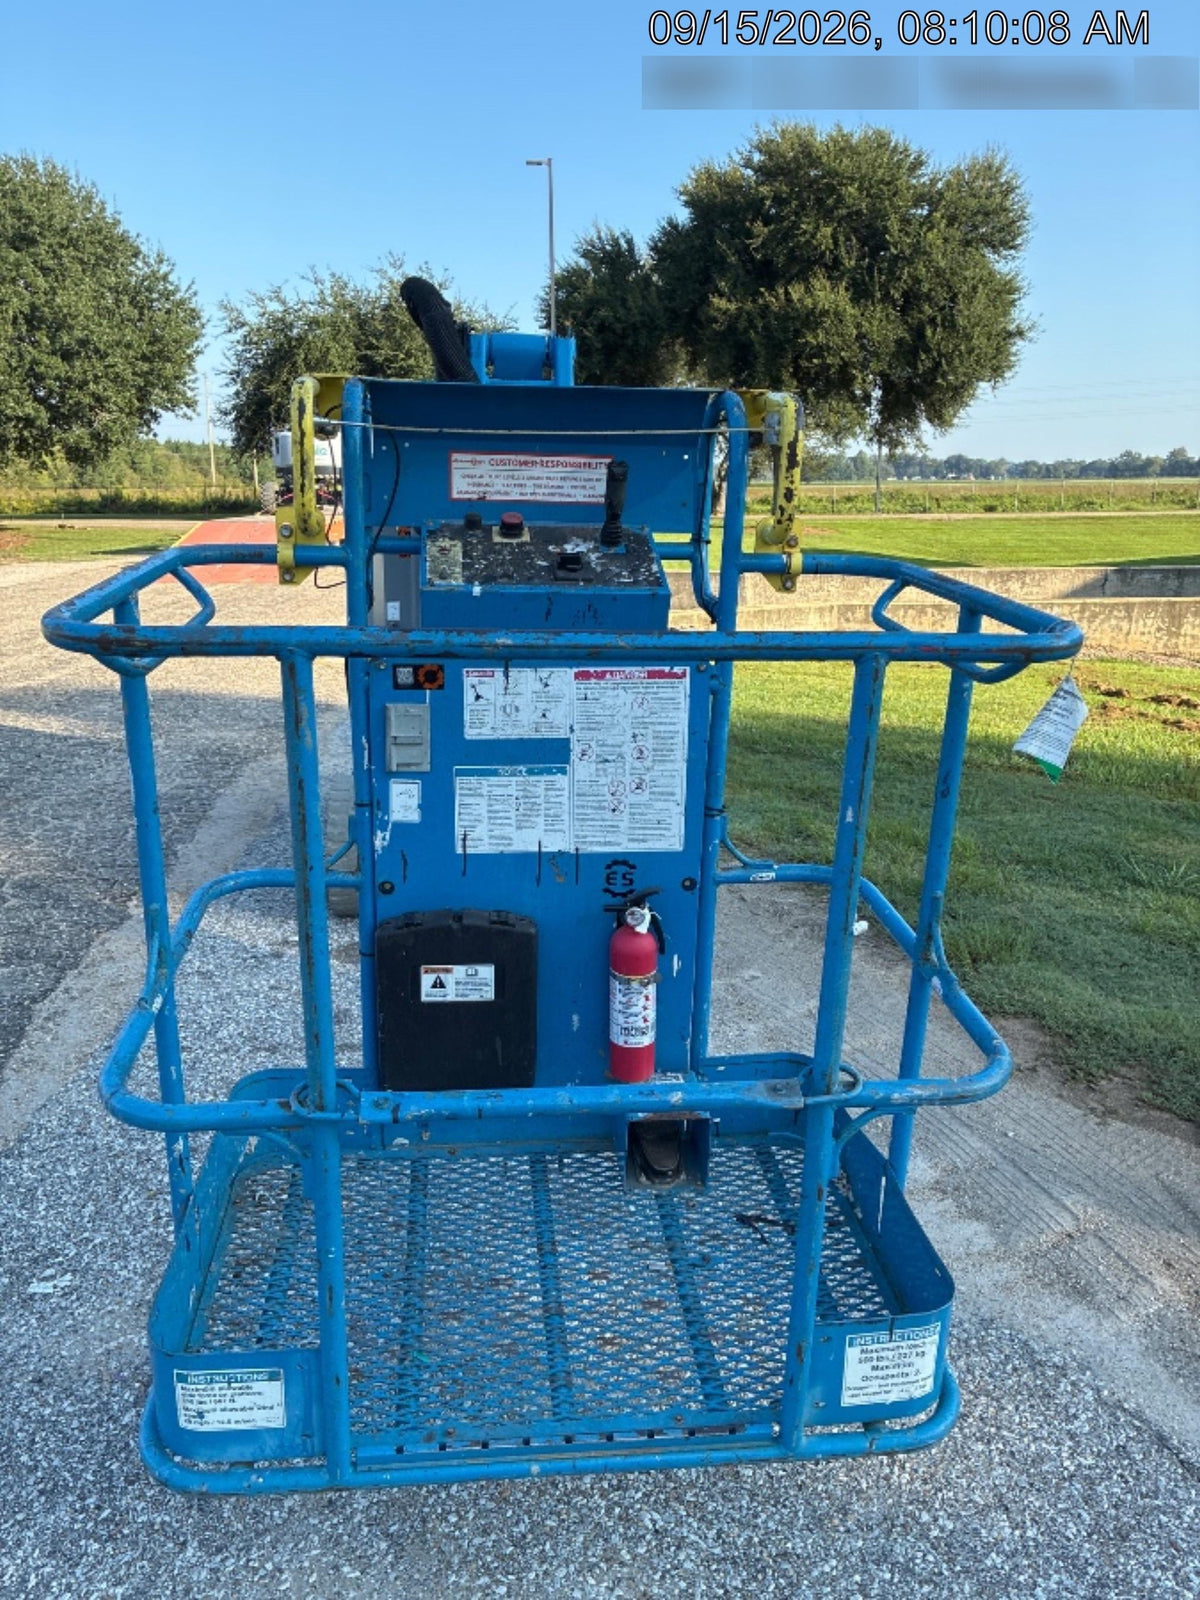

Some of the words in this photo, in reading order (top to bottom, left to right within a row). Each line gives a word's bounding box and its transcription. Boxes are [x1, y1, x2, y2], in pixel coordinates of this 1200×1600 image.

[489, 458, 539, 468] CUSTOMER
[605, 871, 634, 886] ES
[187, 1372, 268, 1384] INSTRUCTIONS
